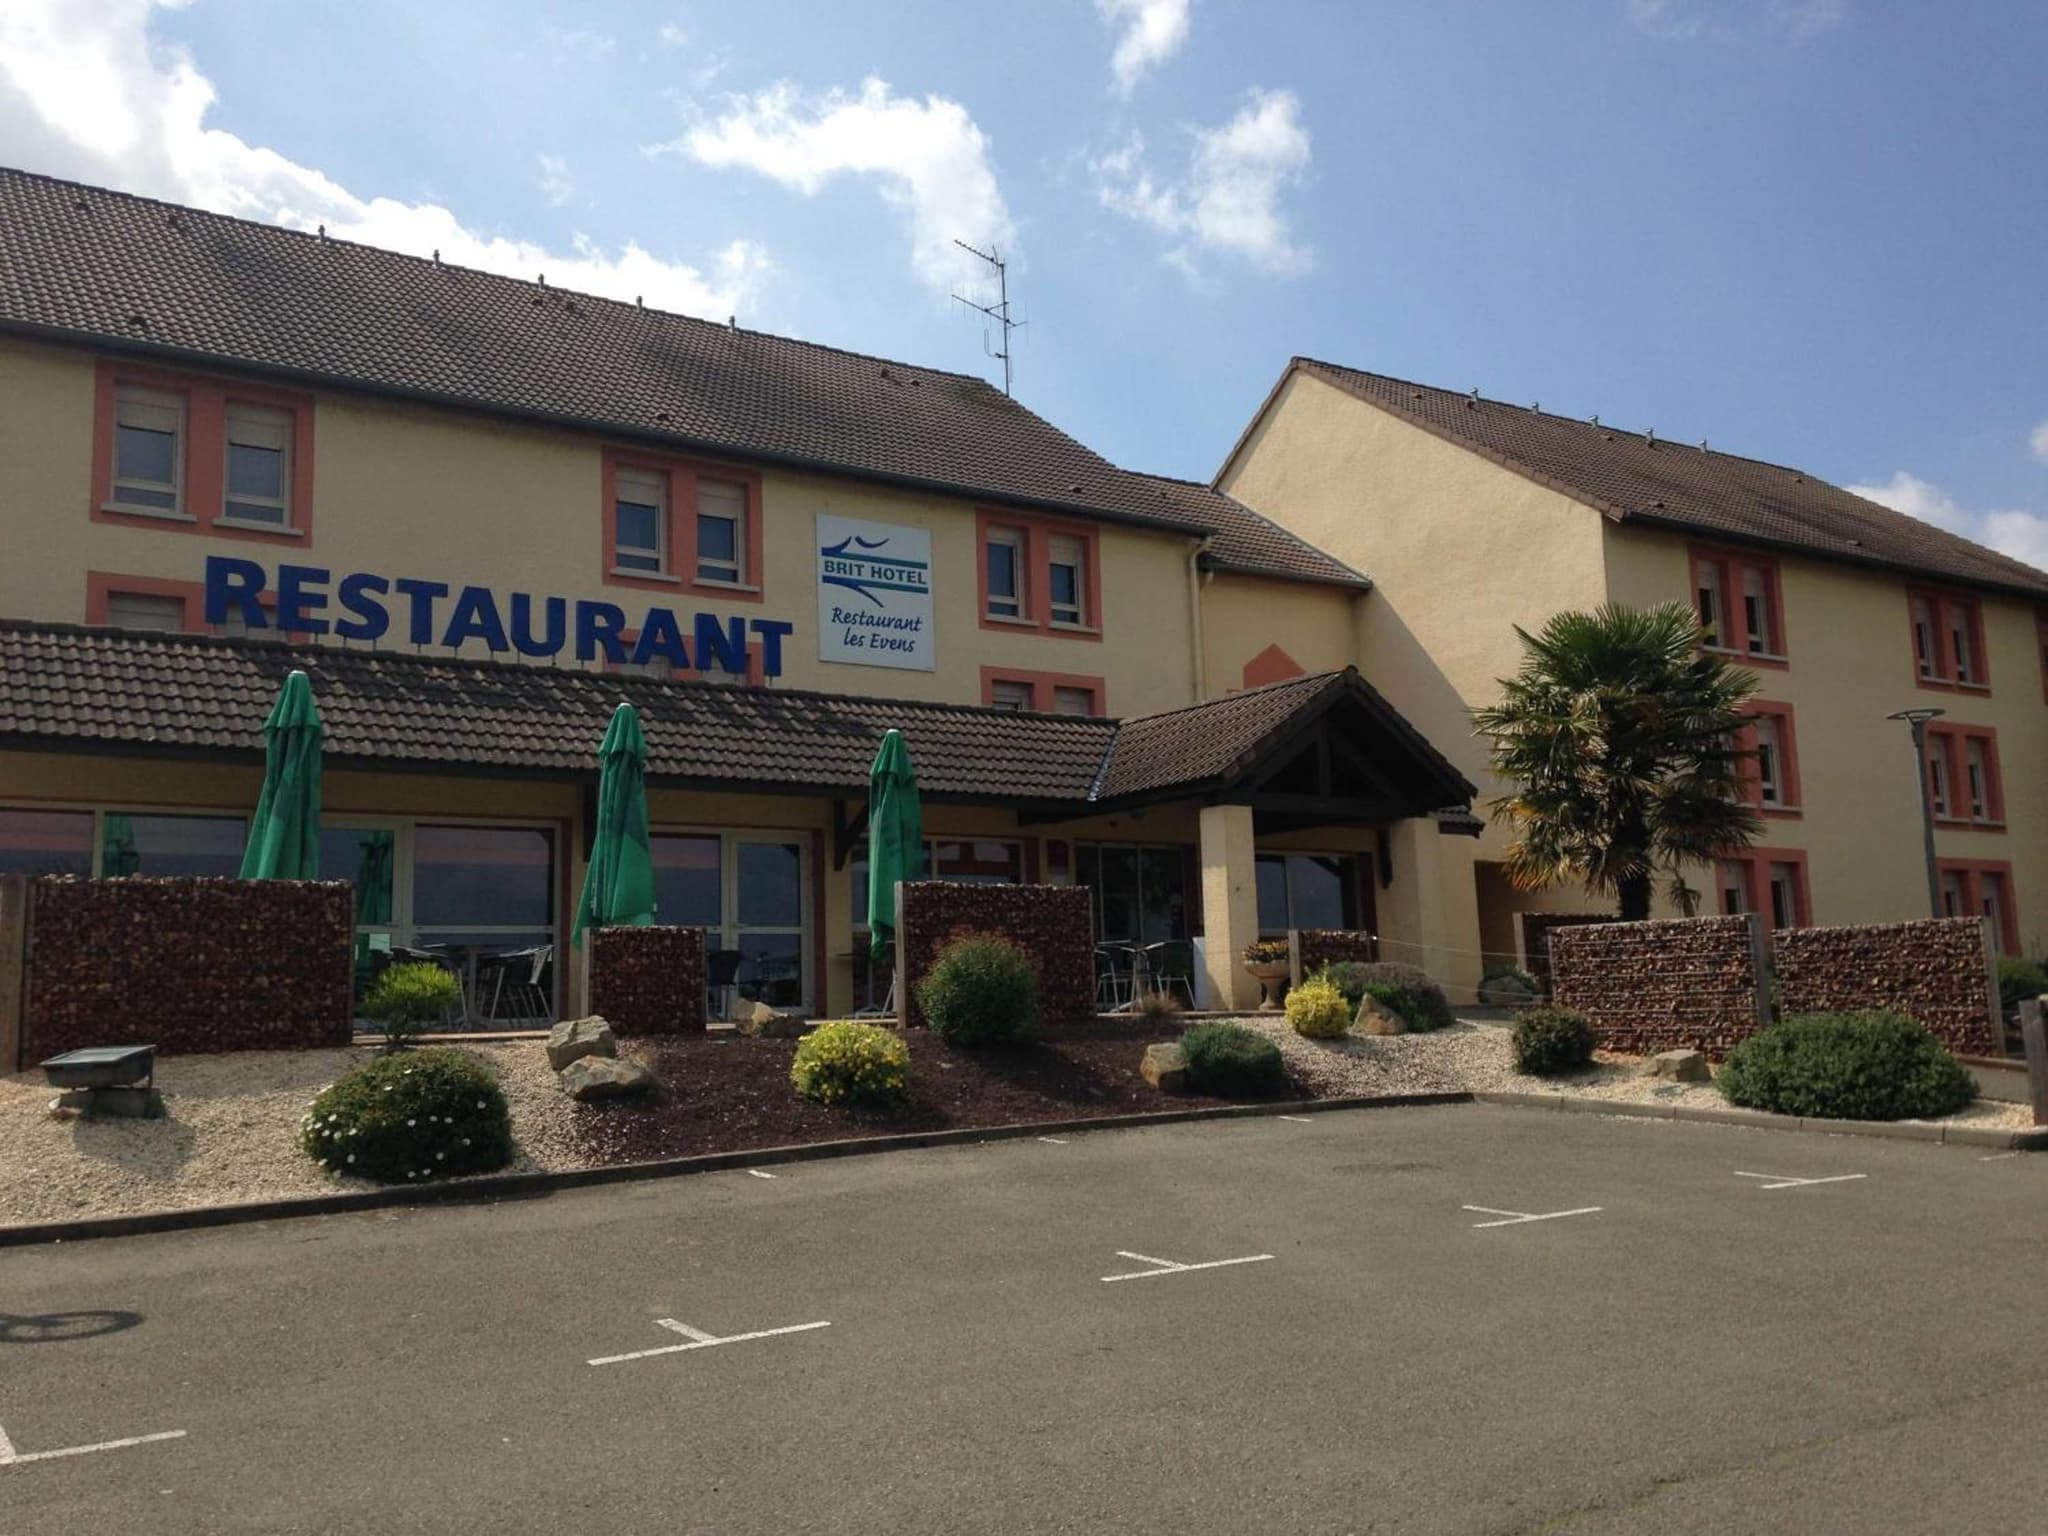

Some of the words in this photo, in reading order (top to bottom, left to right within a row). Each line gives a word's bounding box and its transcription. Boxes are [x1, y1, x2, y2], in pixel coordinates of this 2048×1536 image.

[824, 560, 865, 577] BRIT
[871, 566, 927, 585] HOTEL
[205, 556, 793, 676] RESTAURANT
[831, 607, 922, 632] Restaurant
[843, 627, 866, 647] les
[870, 633, 916, 653] Evens
